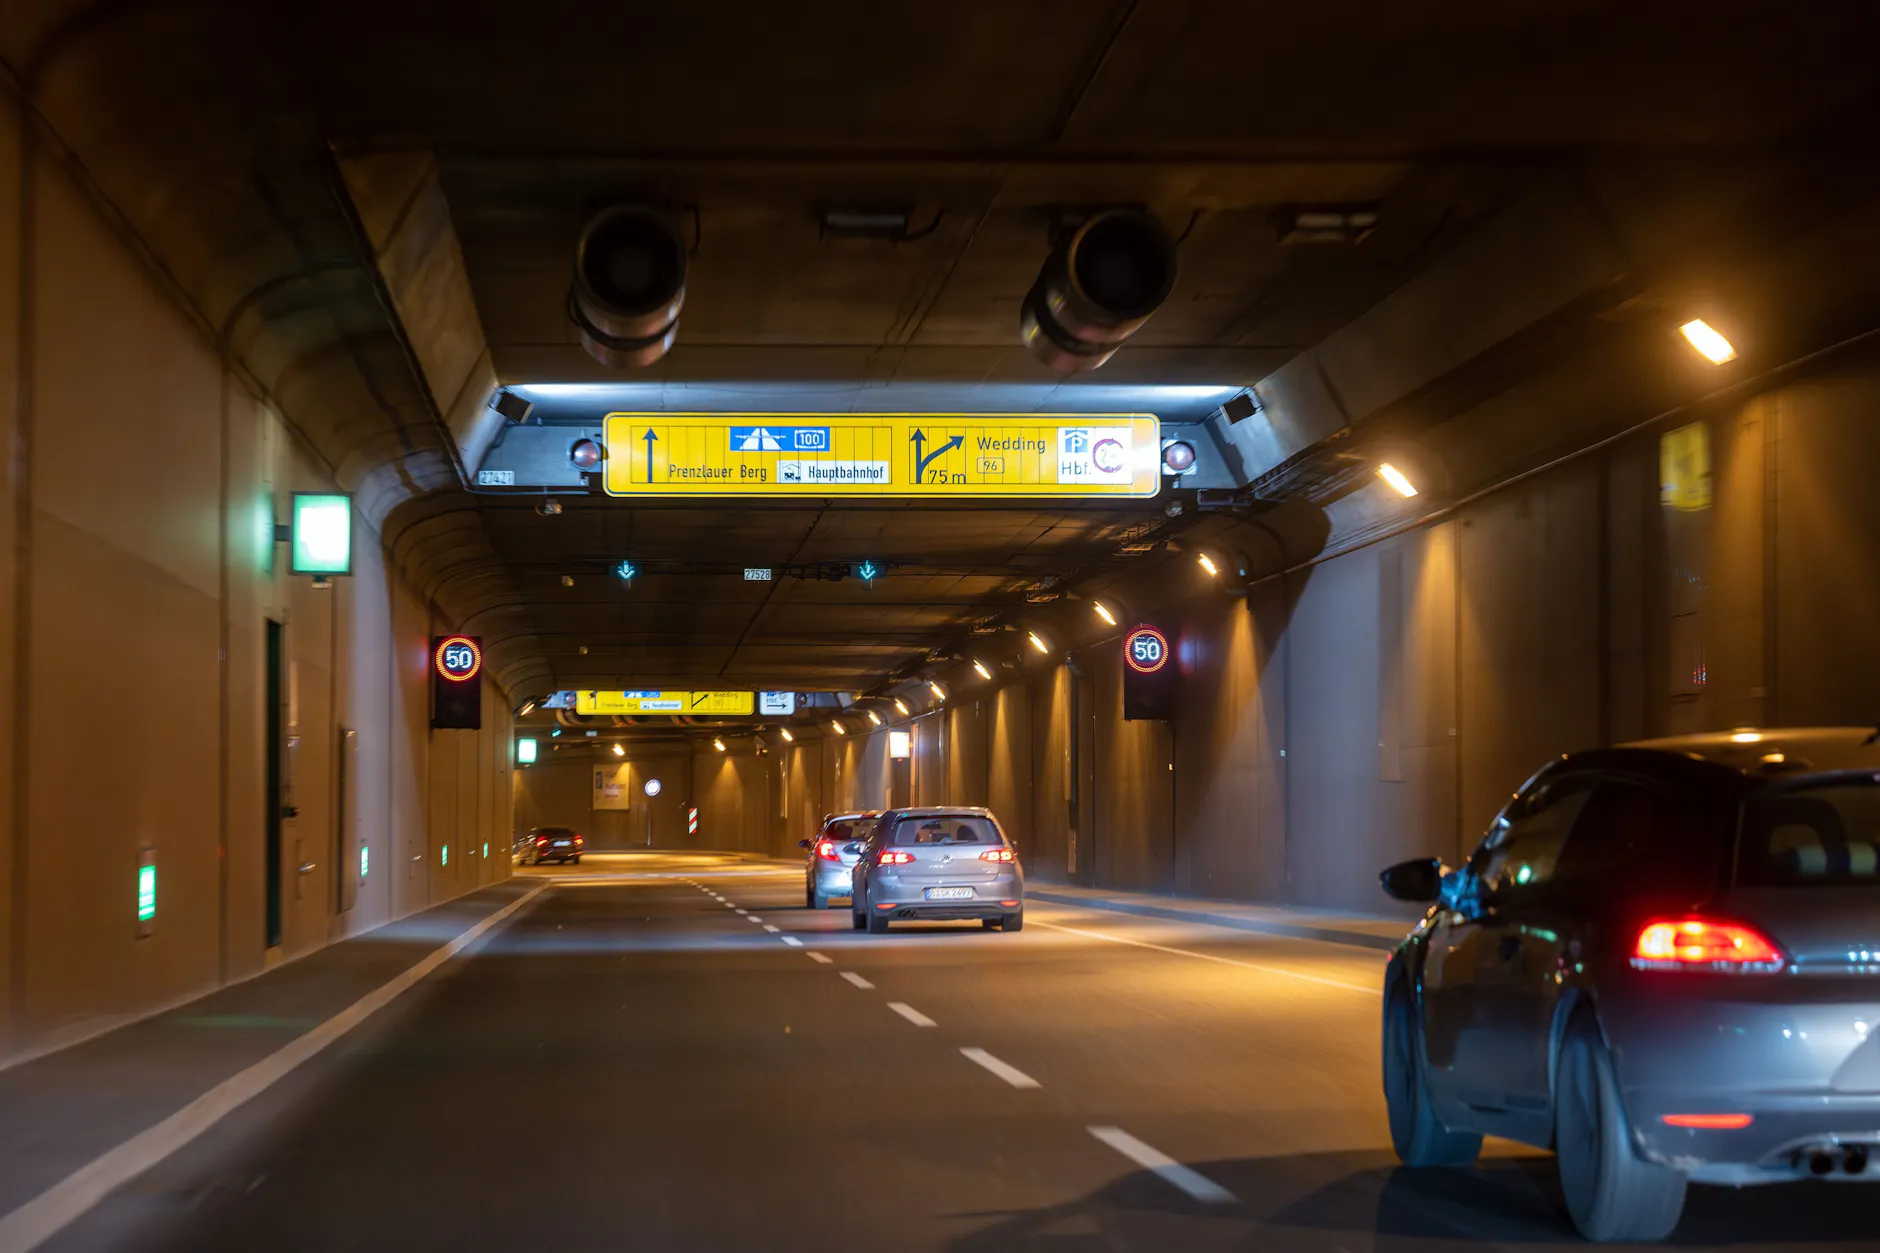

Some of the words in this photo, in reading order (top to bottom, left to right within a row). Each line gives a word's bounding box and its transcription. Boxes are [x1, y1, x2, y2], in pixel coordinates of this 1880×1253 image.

[799, 432, 820, 446] 100
[977, 436, 1046, 454] Wedding
[669, 465, 733, 478] Prenzlauer
[740, 465, 767, 481] Berg
[808, 465, 884, 481] Hauptbahnhof
[983, 461, 998, 472] 96
[929, 469, 948, 484] 75
[952, 473, 966, 484] m
[745, 569, 770, 579] 27528
[1134, 639, 1160, 660] 50
[446, 648, 473, 669] 50
